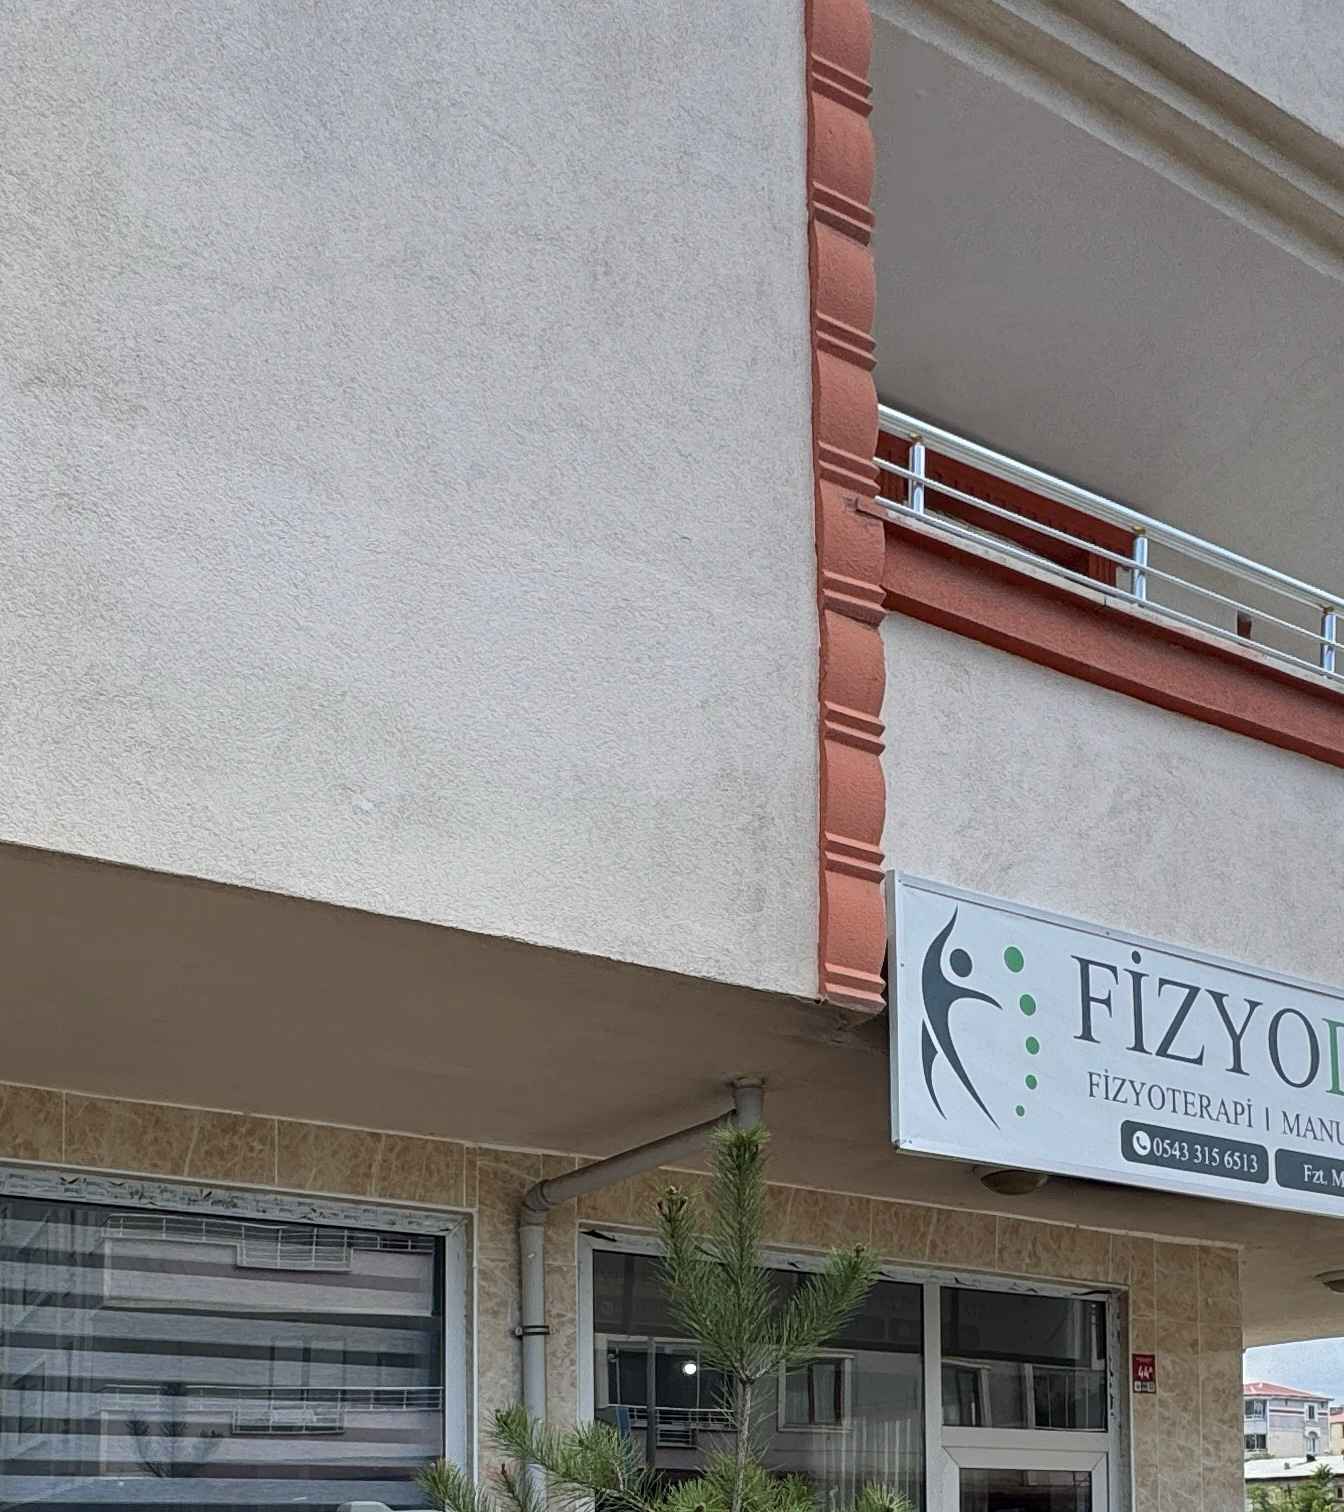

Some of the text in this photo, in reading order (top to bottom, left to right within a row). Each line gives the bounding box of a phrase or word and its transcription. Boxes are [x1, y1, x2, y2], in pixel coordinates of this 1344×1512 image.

[1087, 1069, 1254, 1128] FİZYOTERAPİ
[1153, 1137, 1259, 1174] 0543 315 6513
[1303, 1163, 1328, 1186] Fzt.
